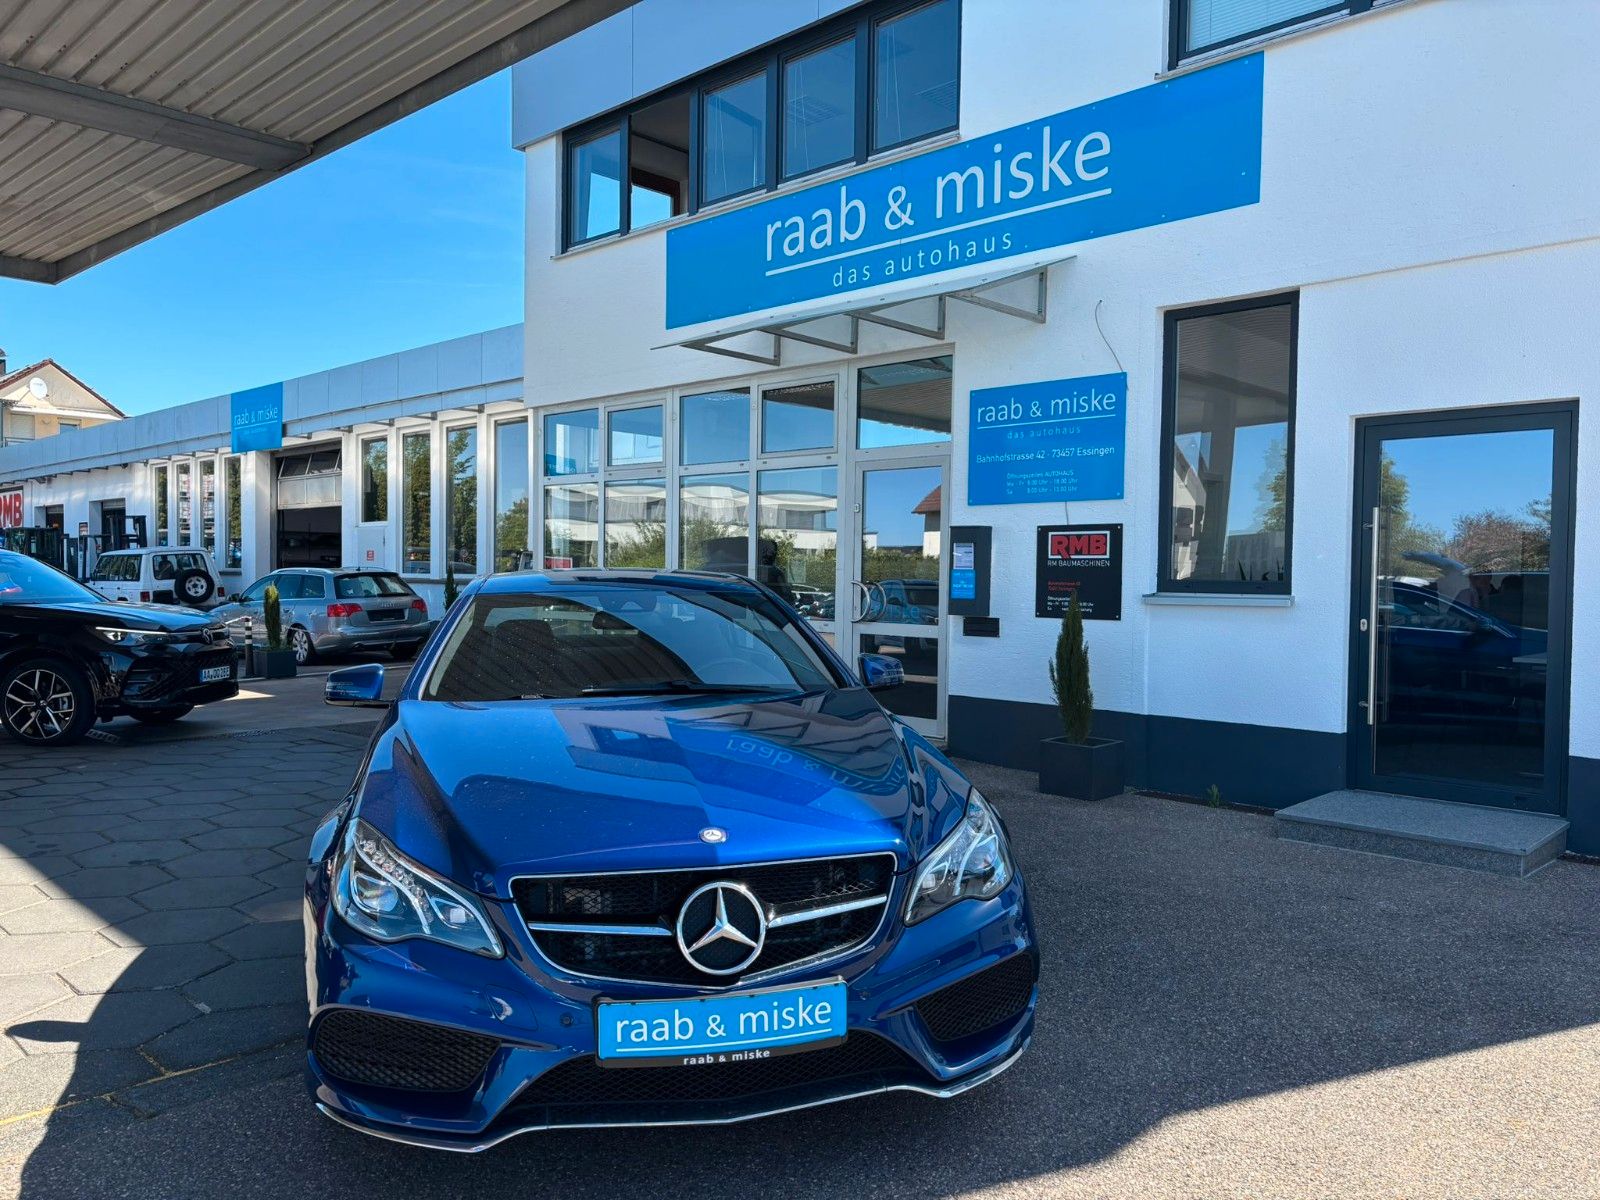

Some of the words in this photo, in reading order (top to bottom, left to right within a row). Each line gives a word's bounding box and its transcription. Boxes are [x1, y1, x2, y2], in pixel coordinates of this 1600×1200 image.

[765, 184, 867, 262] raab
[884, 184, 915, 232] &
[935, 126, 1112, 220] miske
[832, 262, 871, 288] das
[885, 233, 1012, 277] autohaus
[234, 408, 249, 425] raab
[977, 397, 1023, 424] raab
[1029, 400, 1042, 418] &
[1050, 388, 1116, 416] miske
[1007, 430, 1025, 440] das
[1029, 425, 1081, 438] autohaus
[976, 451, 1034, 464] Bahnhofstrasse
[1035, 450, 1045, 459] 42
[1076, 446, 1115, 457] Essingen
[0, 492, 23, 528] MB
[1051, 534, 1107, 560] RMB
[1058, 559, 1111, 567] BAUMASCHINEN
[616, 1009, 694, 1043] raab
[705, 1014, 727, 1038] &
[739, 996, 832, 1035] miske
[683, 1054, 714, 1065] raab
[718, 1054, 726, 1062] &
[732, 1048, 770, 1062] miske
